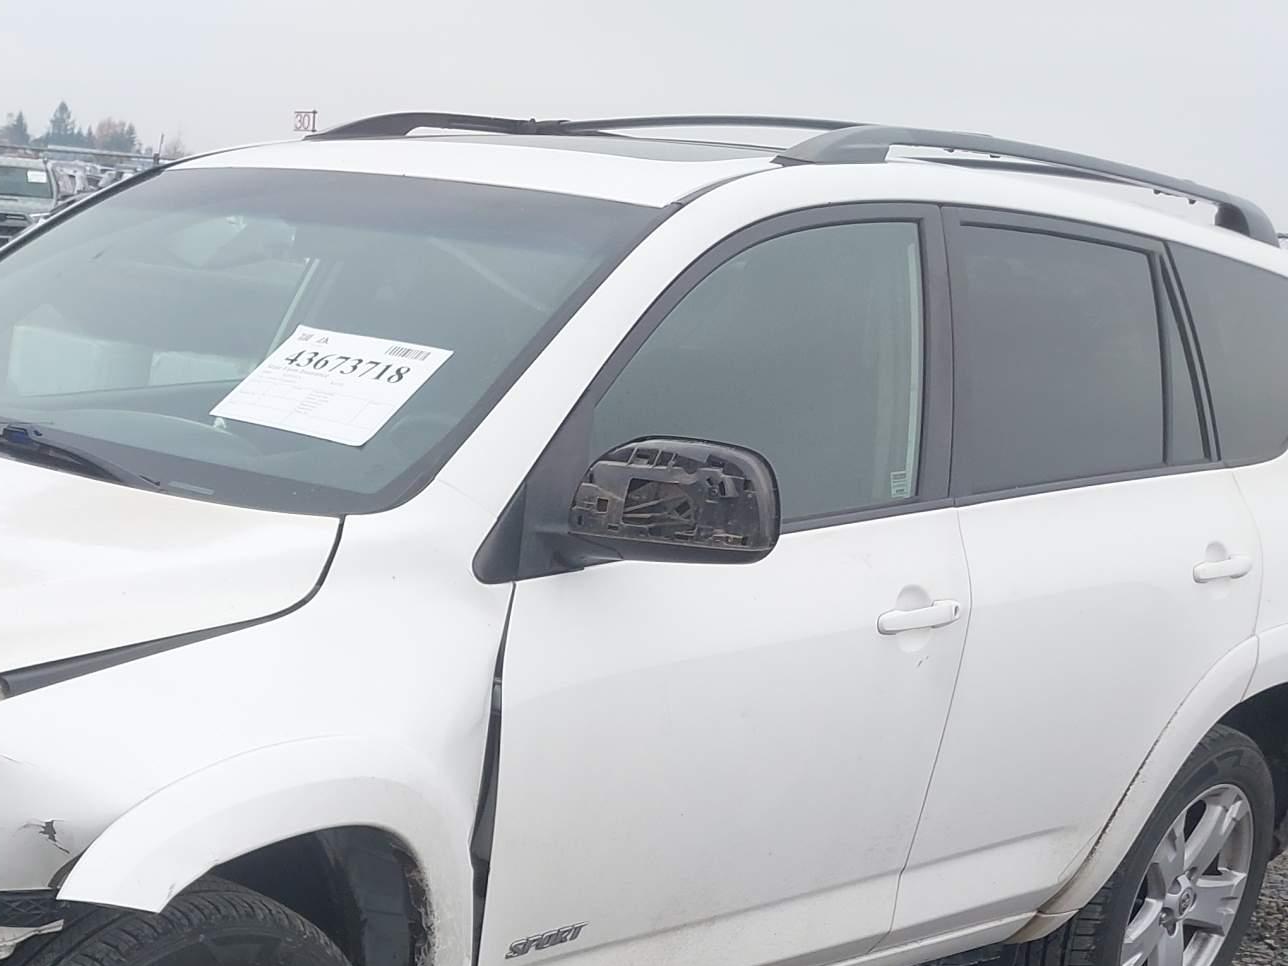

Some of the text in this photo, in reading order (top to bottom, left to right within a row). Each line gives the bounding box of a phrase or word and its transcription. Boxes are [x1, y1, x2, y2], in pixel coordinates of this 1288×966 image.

[295, 113, 310, 130] 30
[285, 350, 411, 384] 43673718
[505, 921, 589, 959] SPORT
